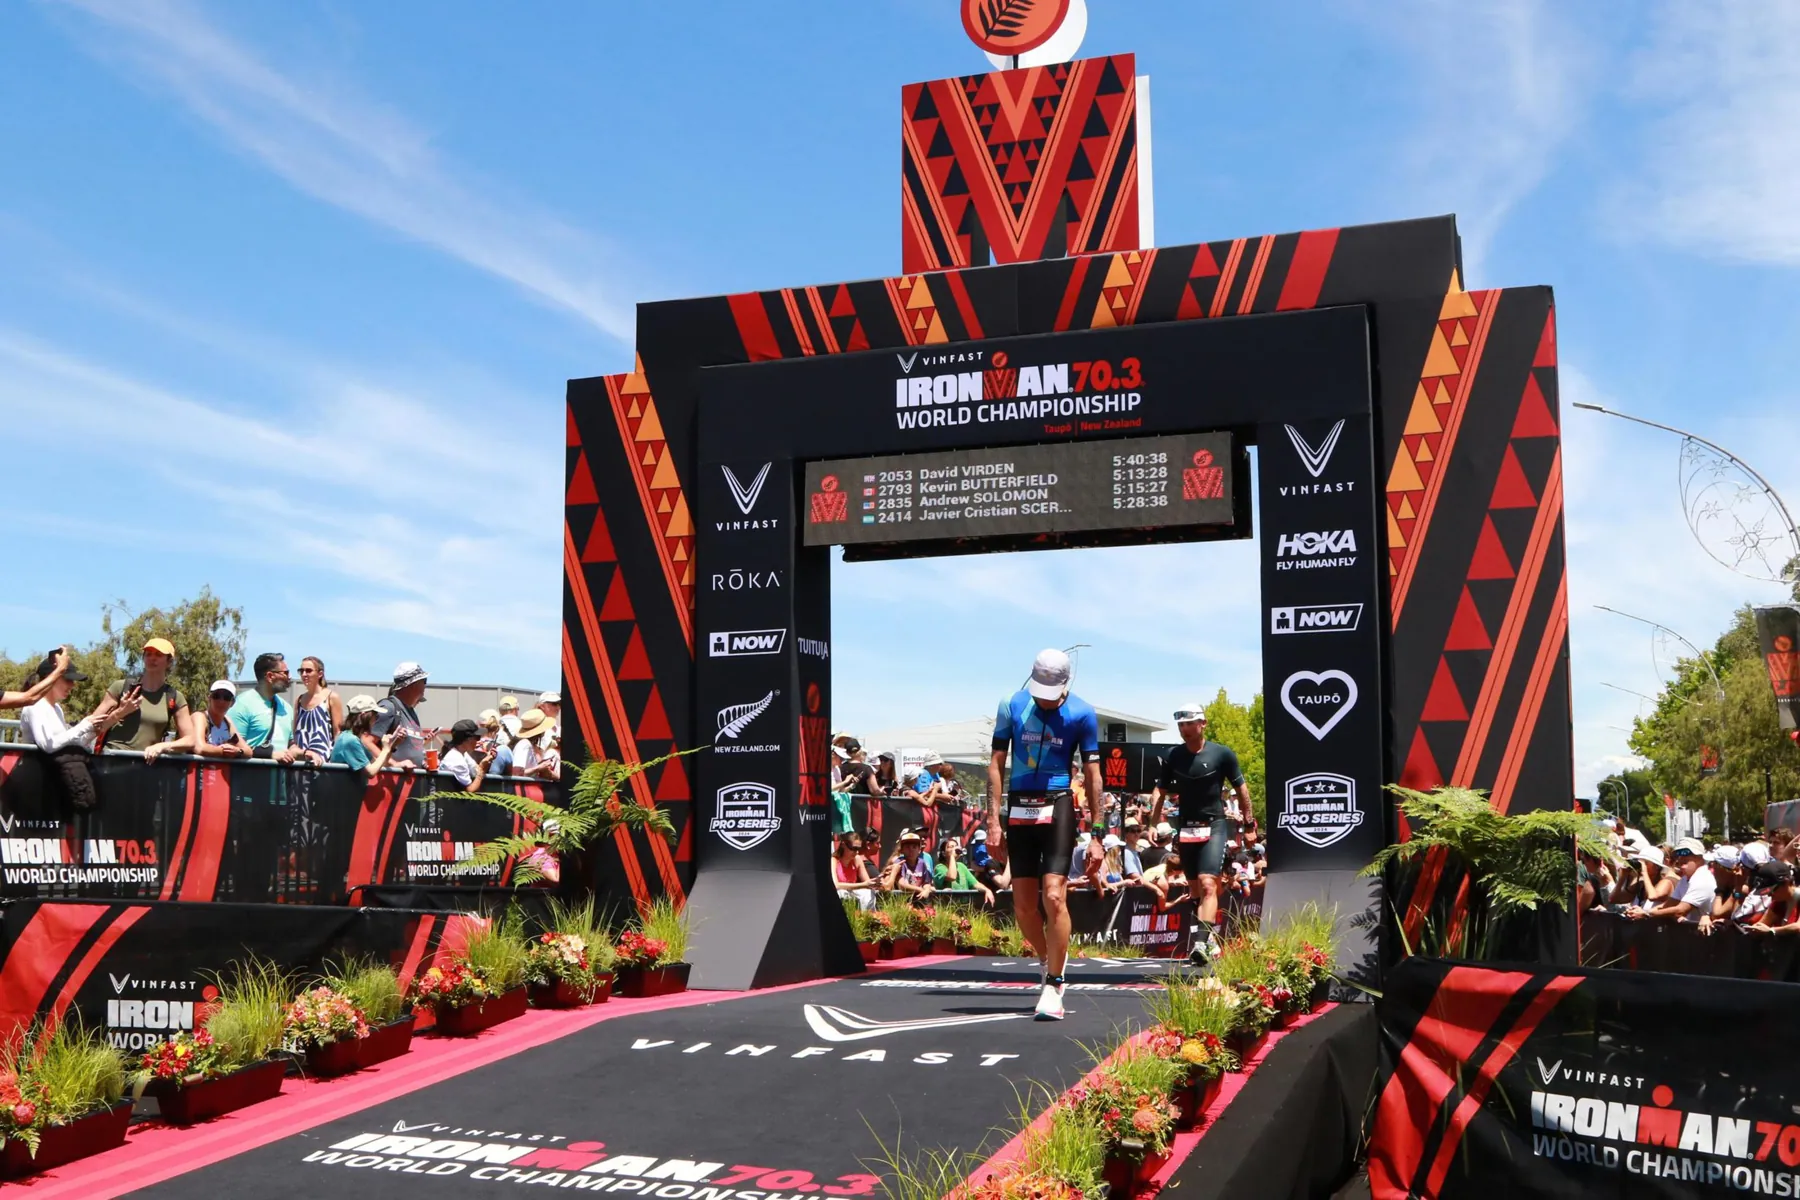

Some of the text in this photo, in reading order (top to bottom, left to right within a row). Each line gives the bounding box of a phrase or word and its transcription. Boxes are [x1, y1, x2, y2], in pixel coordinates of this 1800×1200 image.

[923, 352, 983, 366] VINFAST
[896, 352, 1142, 408] IRONMAN 70.3
[897, 392, 1141, 429] WORLD CHAMPIONSHIP
[1081, 420, 1102, 431] New
[1104, 417, 1142, 429] Zealand
[879, 452, 1168, 483] 2053 David VIRDEN 5:40:38
[879, 466, 1168, 496] 2793 Kevin BUTTERFIELD 5:13:28
[1279, 482, 1355, 496] VINFAST
[878, 481, 1168, 510] 2835 Andrew SOLOMON 5:15:27
[878, 511, 912, 524] 2414
[919, 508, 961, 521] Javier
[964, 505, 1017, 519] Cristian
[1113, 495, 1168, 509] 5:28:38
[716, 519, 778, 531] VINFAST
[1276, 529, 1357, 556] HOKA
[1276, 557, 1356, 570] FLY HUMAN FLY
[1299, 610, 1353, 627] NOW
[732, 634, 778, 650] NOW
[726, 806, 766, 818] IRONMAN
[1296, 799, 1345, 812] IRONMAN
[15, 820, 60, 829] VINFAST
[712, 818, 778, 829] PRO SERIES
[1280, 812, 1362, 825] PRO SERIES
[116, 839, 158, 864] 70.3
[406, 832, 475, 861] IRONMAN
[4, 867, 158, 884] WORLD CHAMPIONSHIP
[407, 864, 438, 877] WORLD
[131, 979, 196, 990] VINFAST
[630, 1038, 1020, 1067] VINFAST
[1563, 1068, 1645, 1089] VINFAST
[1531, 1085, 1751, 1160] IRONMAN
[432, 1125, 566, 1142] VINFAST
[1533, 1134, 1619, 1169] WORLD
[328, 1133, 881, 1195] IRONMAN 70.3
[302, 1151, 857, 1200] WORLD CHAMPIONS
